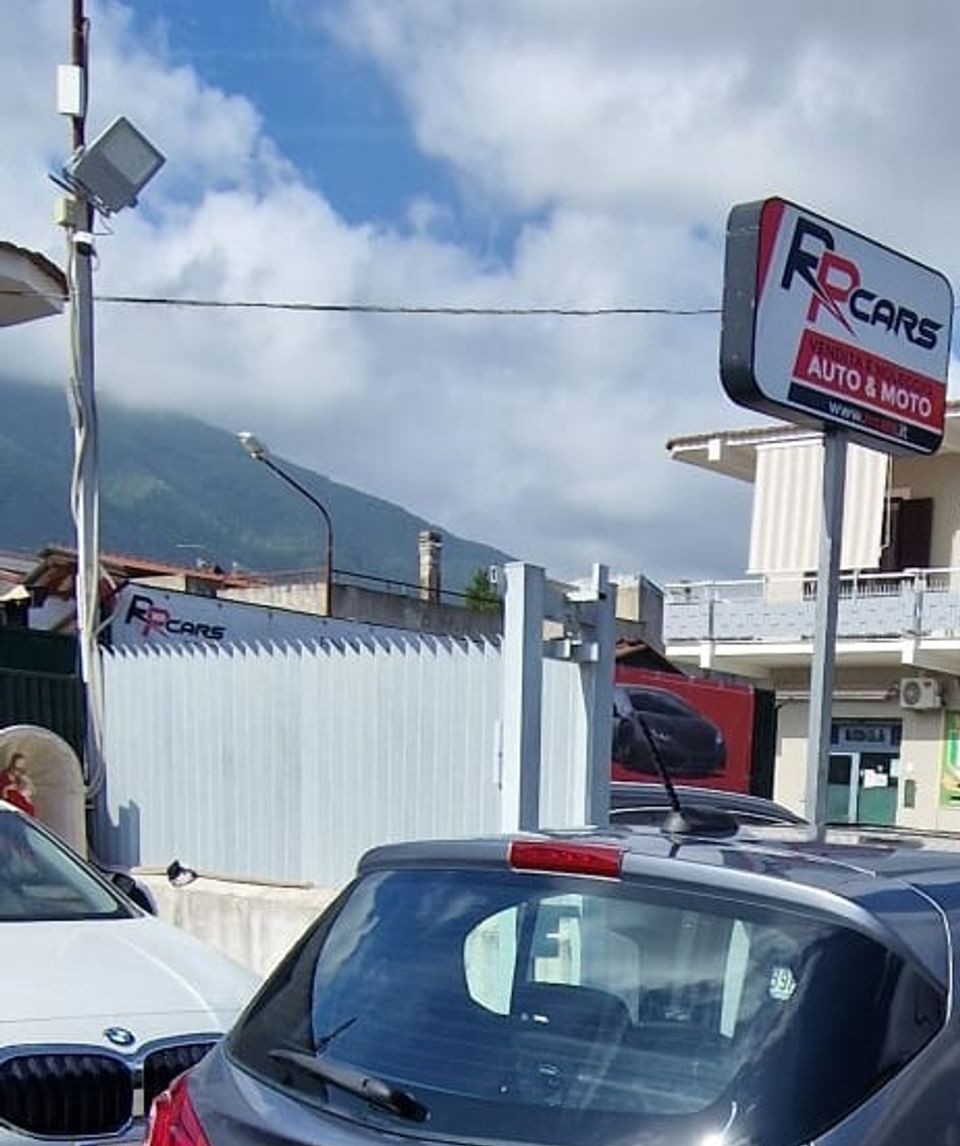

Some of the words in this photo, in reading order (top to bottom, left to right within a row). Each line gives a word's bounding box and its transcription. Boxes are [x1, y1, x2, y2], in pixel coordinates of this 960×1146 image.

[808, 354, 861, 391] AUTO
[864, 376, 877, 397] &
[881, 382, 932, 417] MOTO
